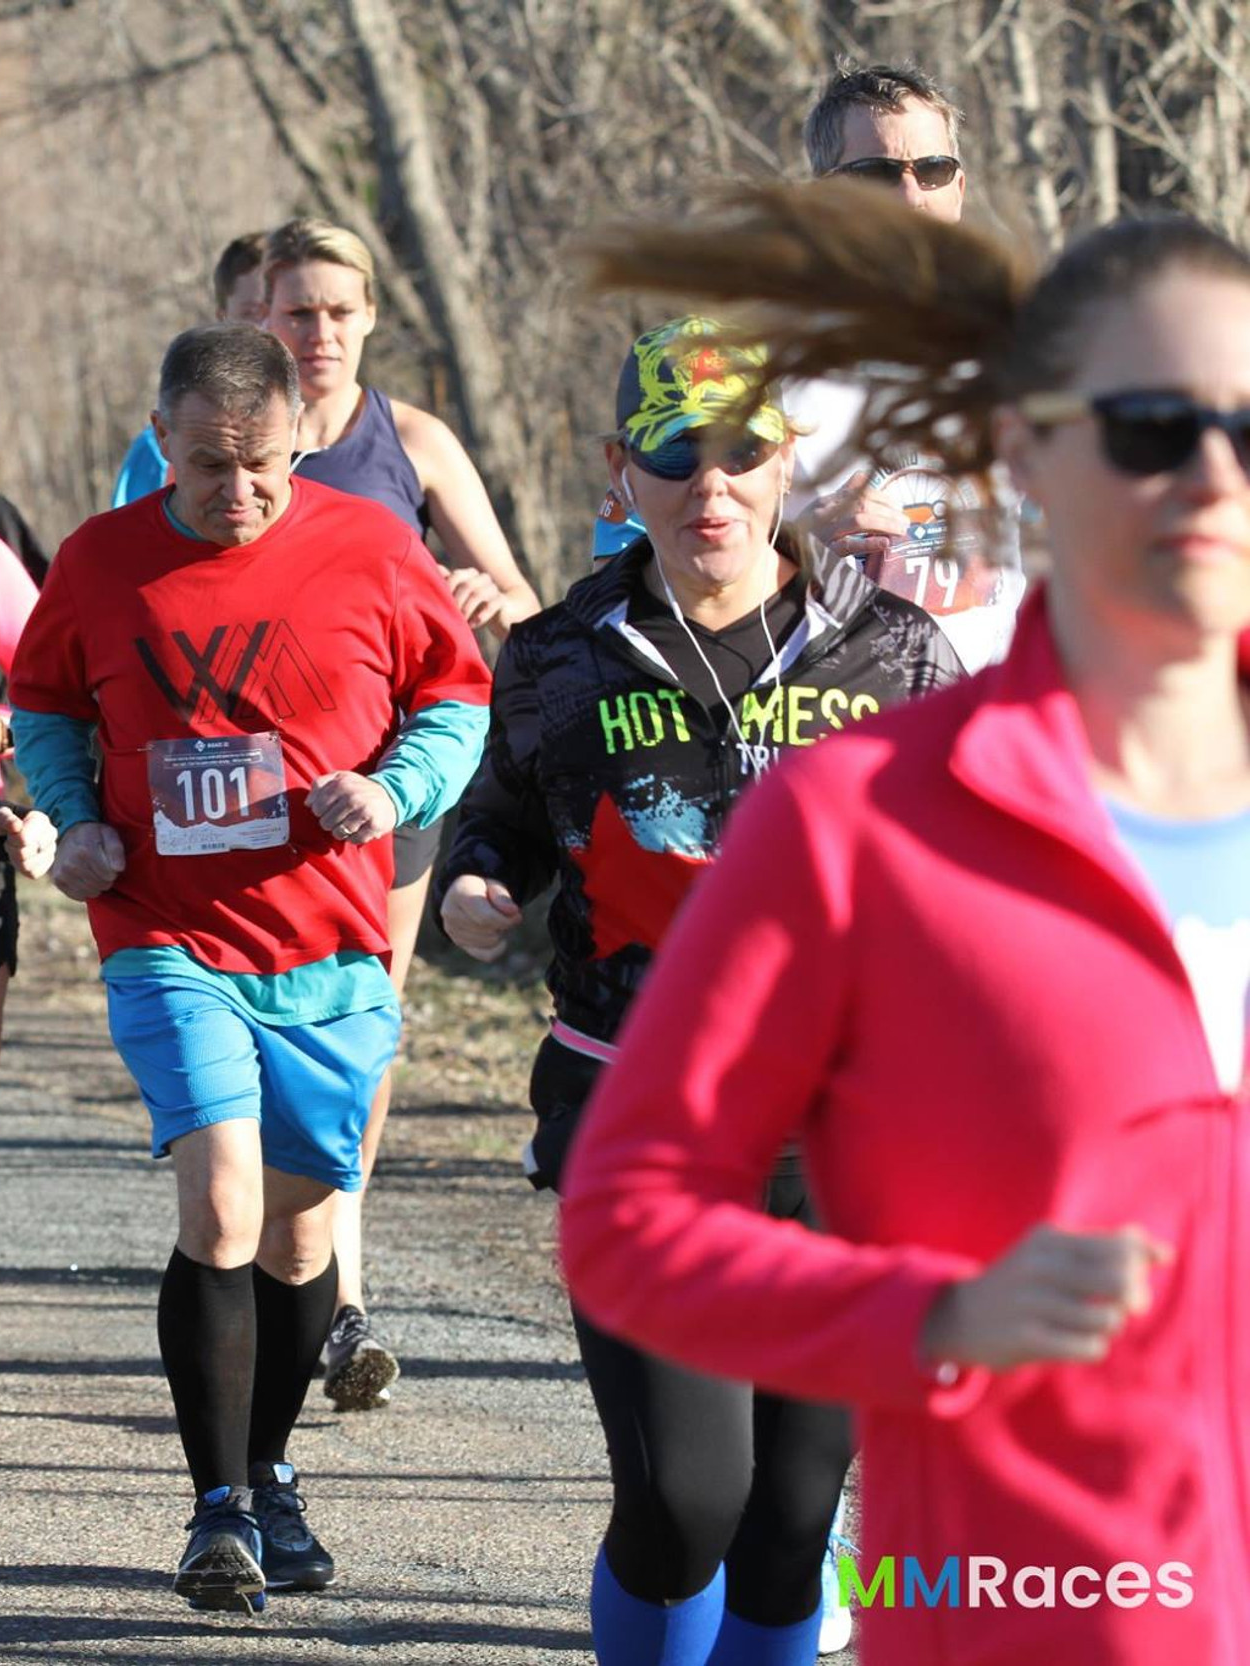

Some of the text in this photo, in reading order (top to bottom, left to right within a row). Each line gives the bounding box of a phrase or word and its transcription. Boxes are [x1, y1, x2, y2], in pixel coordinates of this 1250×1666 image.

[905, 556, 958, 608] 79
[599, 687, 690, 755] HOT
[176, 766, 250, 821] 101
